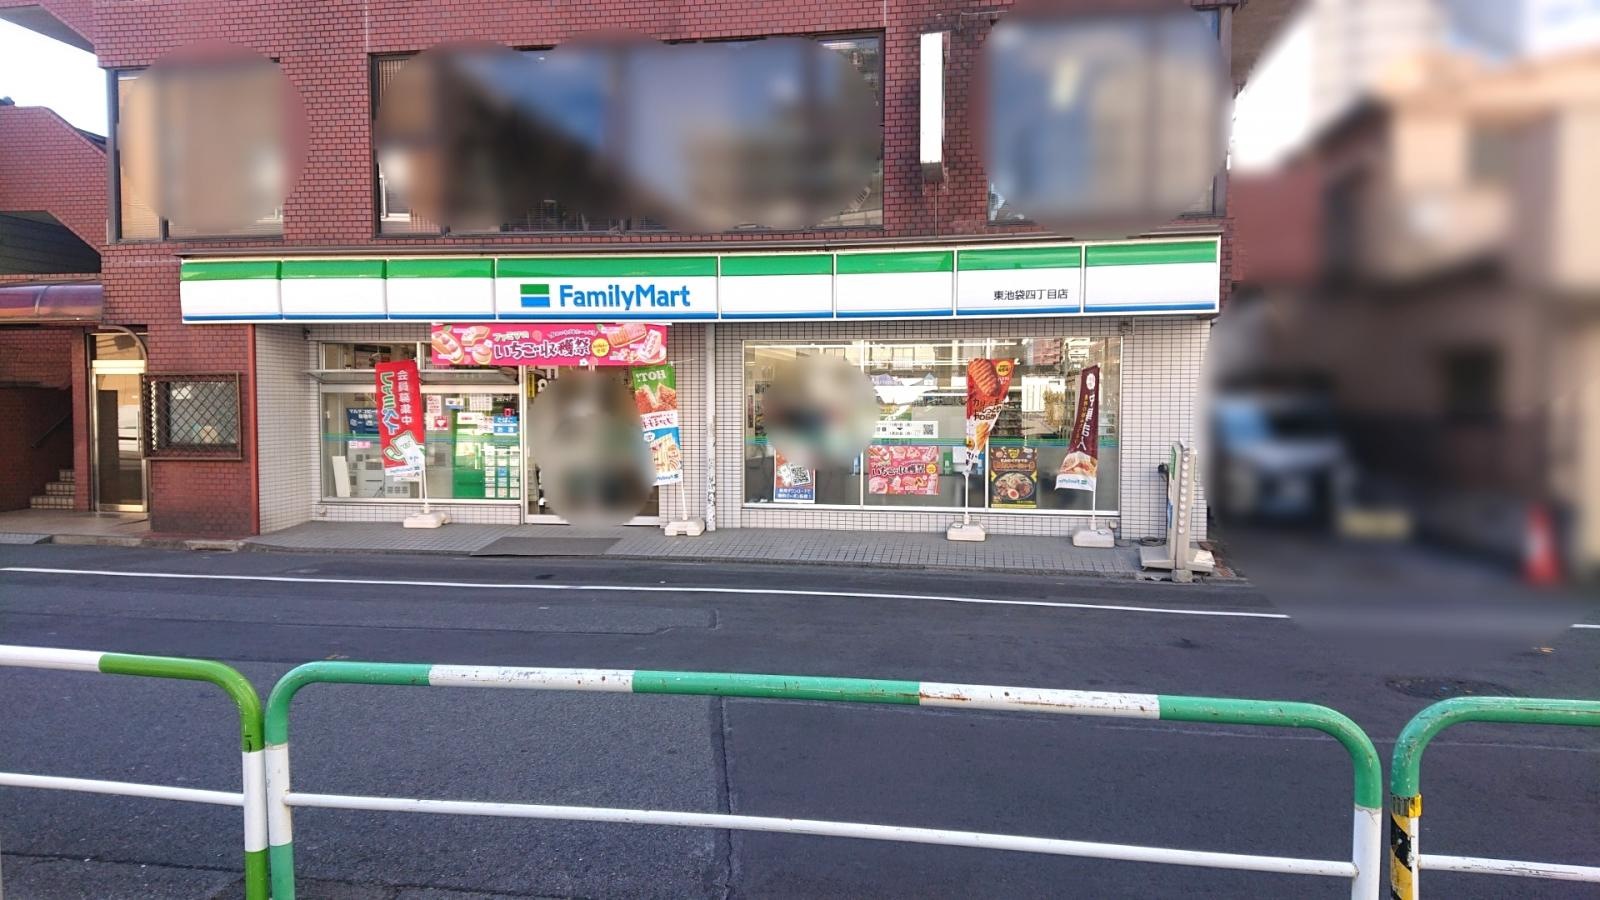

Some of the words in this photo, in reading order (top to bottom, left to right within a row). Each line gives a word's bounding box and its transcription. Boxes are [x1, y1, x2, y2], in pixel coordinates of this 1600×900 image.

[559, 284, 691, 311] FamilyMart
[993, 289, 1069, 301] 東池袋四丁目店
[494, 337, 591, 360] いちご収穫祭
